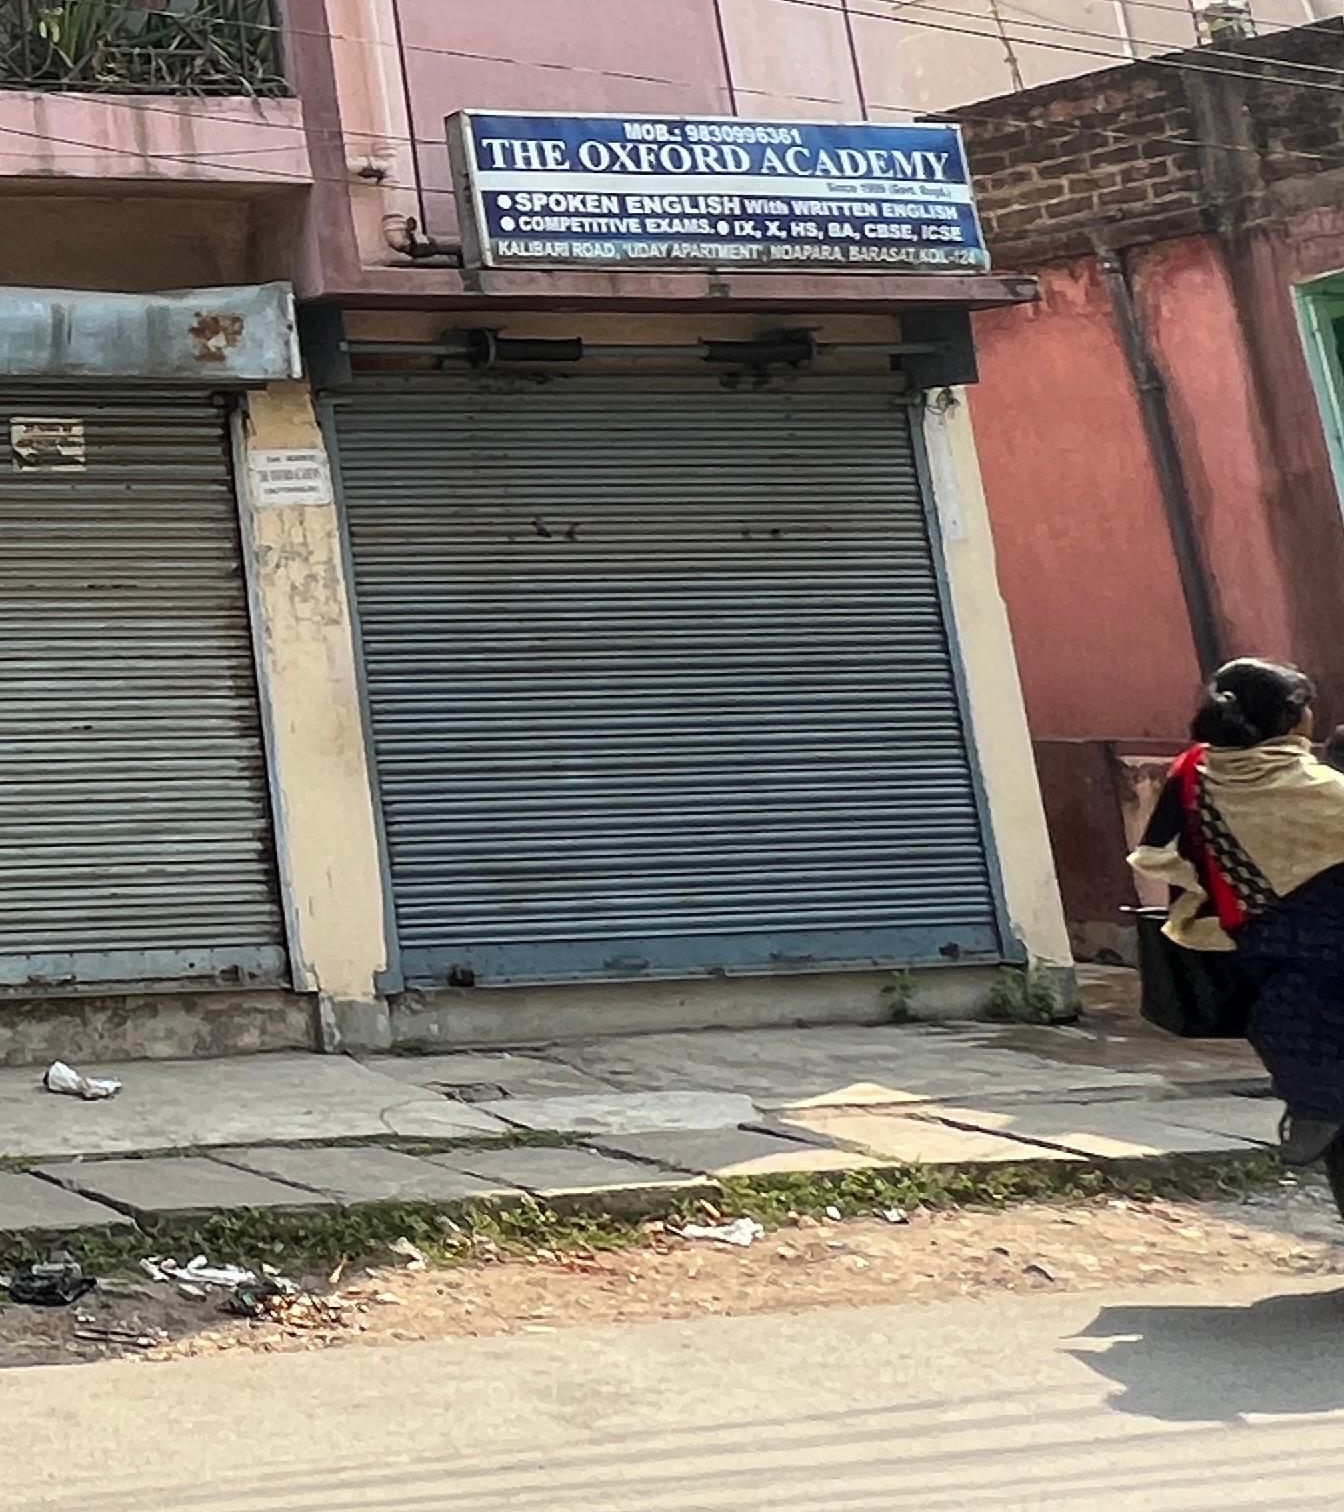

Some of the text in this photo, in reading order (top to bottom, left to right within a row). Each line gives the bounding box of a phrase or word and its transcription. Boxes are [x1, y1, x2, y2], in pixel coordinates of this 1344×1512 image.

[482, 138, 949, 180] THE OXFORD ACADEMY
[515, 192, 620, 215] SPOKEN
[624, 195, 741, 216] ENGLISH
[790, 200, 879, 218] WRITTEN
[882, 202, 958, 220] ENGLISH
[518, 216, 642, 233] COMPETITIVE
[791, 222, 824, 240] HS,
[864, 223, 918, 241] CBSE,
[921, 224, 965, 242] ICSE
[498, 240, 570, 257] KALIBARI
